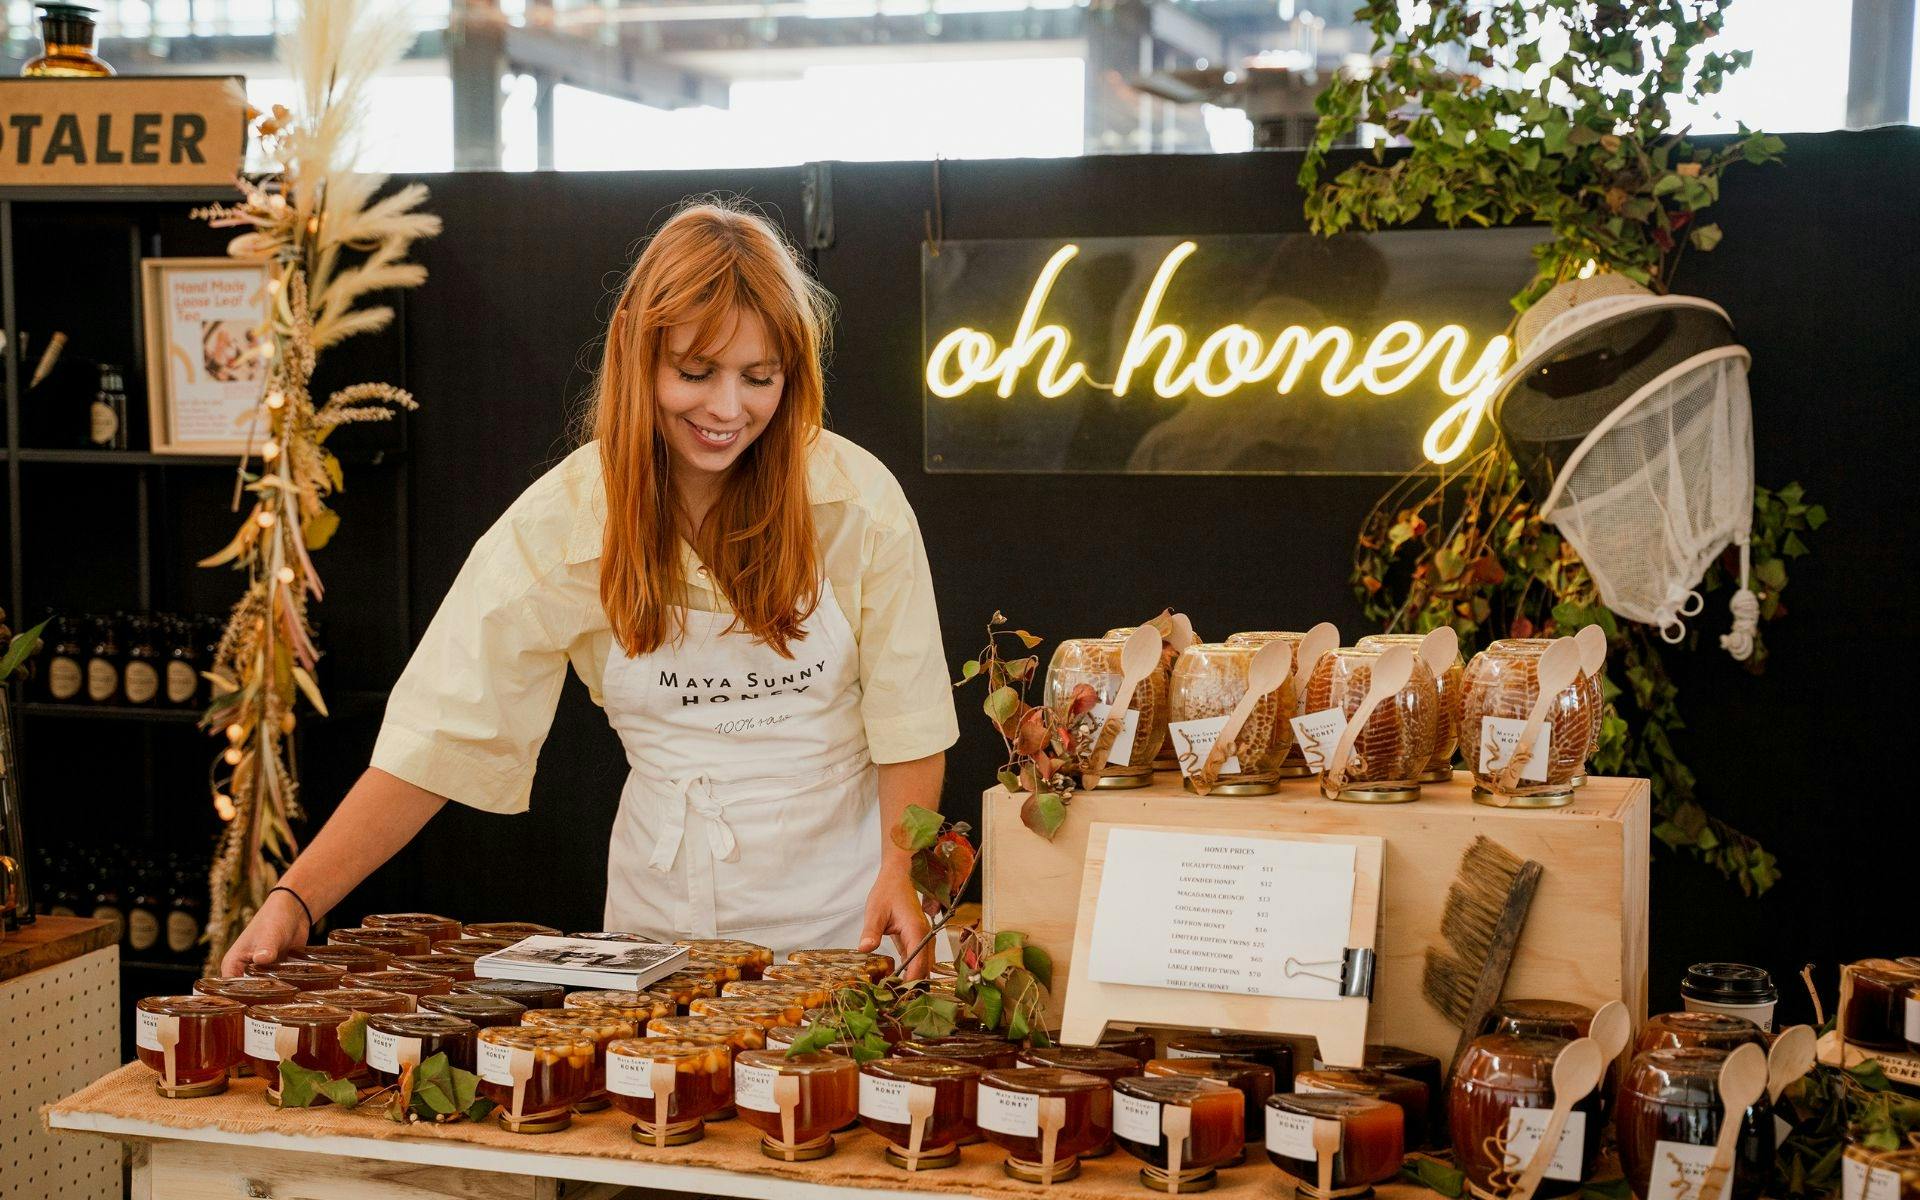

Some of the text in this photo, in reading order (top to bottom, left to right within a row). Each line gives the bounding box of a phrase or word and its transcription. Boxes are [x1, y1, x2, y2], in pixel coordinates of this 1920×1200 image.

[0, 113, 208, 165] TALER
[926, 241, 1509, 464] oh honey
[659, 660, 825, 688] MAYA SUNNY
[682, 685, 810, 706] HONEY
[714, 717, 755, 735] 100%
[1204, 846, 1255, 855] HONEY PRICES
[1222, 863, 1245, 871] HONEY
[1179, 876, 1213, 884] LAVENDER
[1177, 890, 1217, 899] MACADAMIA
[1210, 907, 1233, 915] HONEY
[1173, 919, 1202, 927] SAFFRON
[1171, 933, 1199, 941] LIMITED
[1200, 936, 1227, 944] EDITION
[1228, 939, 1250, 947] TWINS
[1169, 947, 1191, 955] LARGE
[1191, 950, 1233, 960] HONEYCOMB
[1167, 962, 1188, 970] LARGE
[1189, 964, 1218, 973] LIMITED
[1219, 967, 1240, 976] TWINS
[1166, 979, 1187, 987] THREE
[1206, 982, 1229, 991] HONEY
[620, 1064, 645, 1072] HONEY
[999, 1099, 1028, 1108] HONEY
